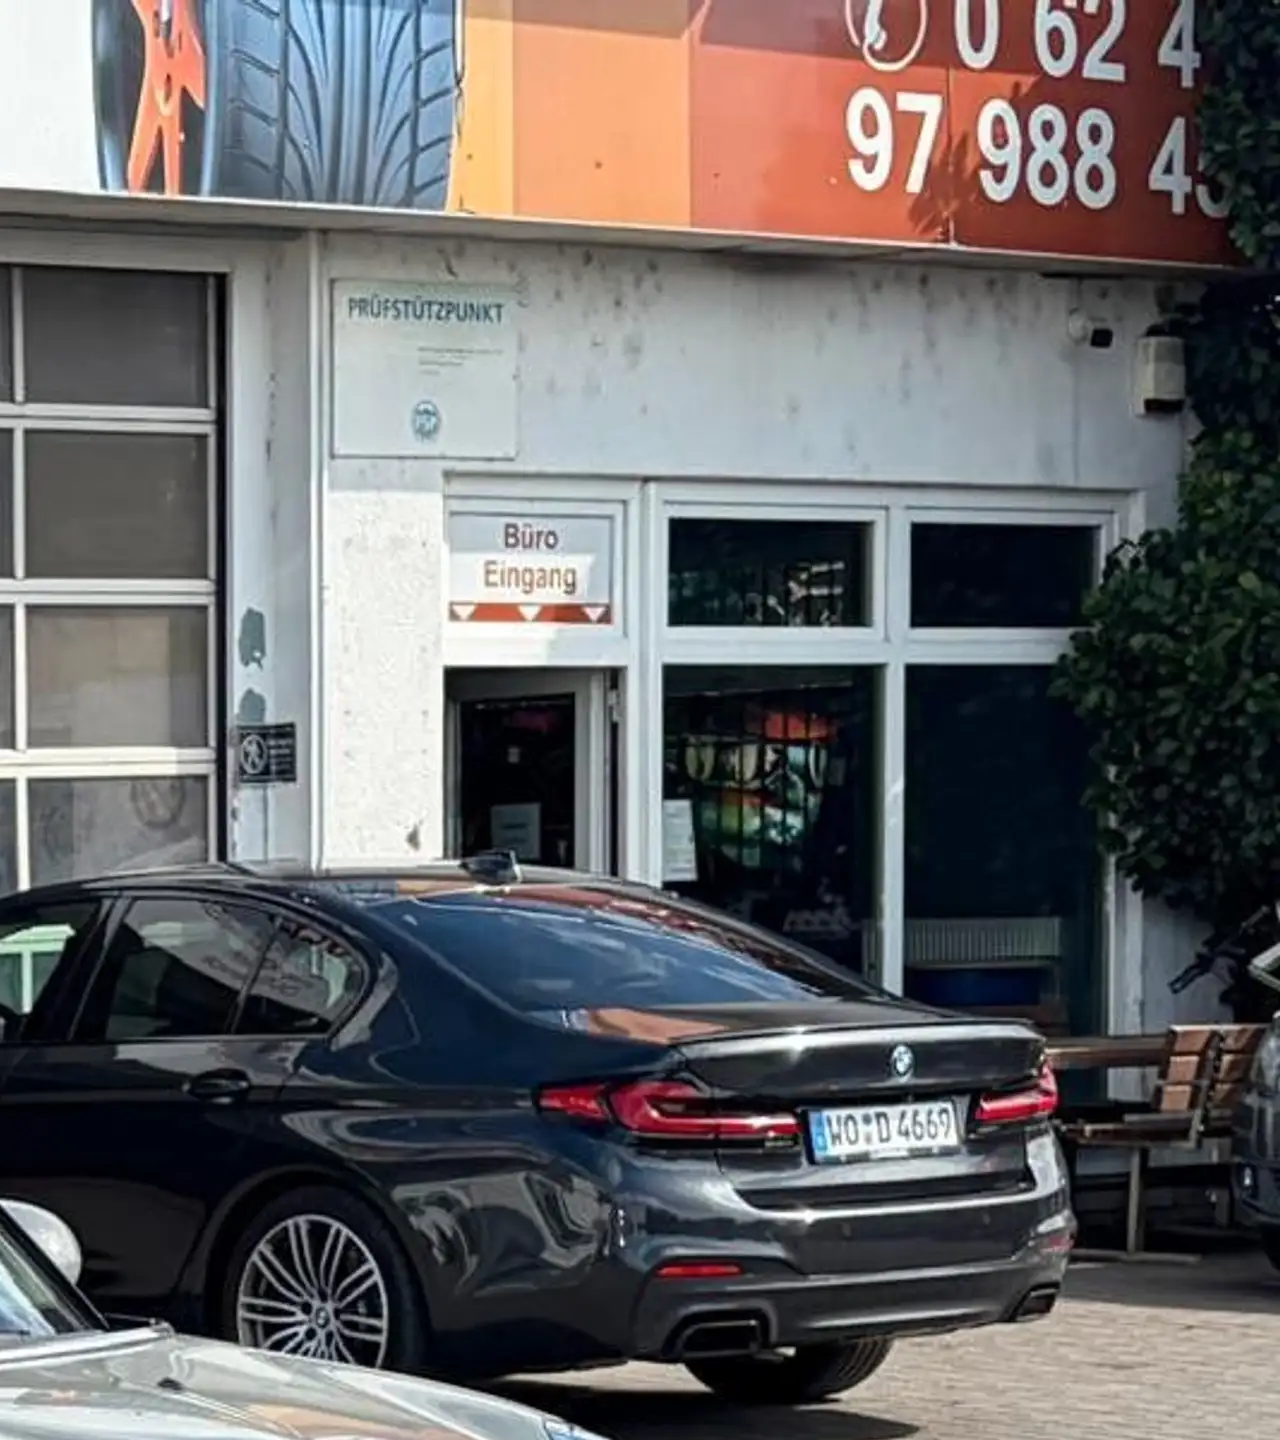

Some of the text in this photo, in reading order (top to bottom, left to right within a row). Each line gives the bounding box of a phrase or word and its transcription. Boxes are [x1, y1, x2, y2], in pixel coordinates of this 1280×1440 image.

[954, 0, 1000, 69] 0
[1034, 0, 1126, 82] 62
[846, 86, 944, 193] 97
[976, 98, 1117, 210] 988
[348, 294, 504, 324] PRÜFSTÜTZPUNKT
[504, 522, 559, 549] Büro
[483, 560, 577, 595] Eingang
